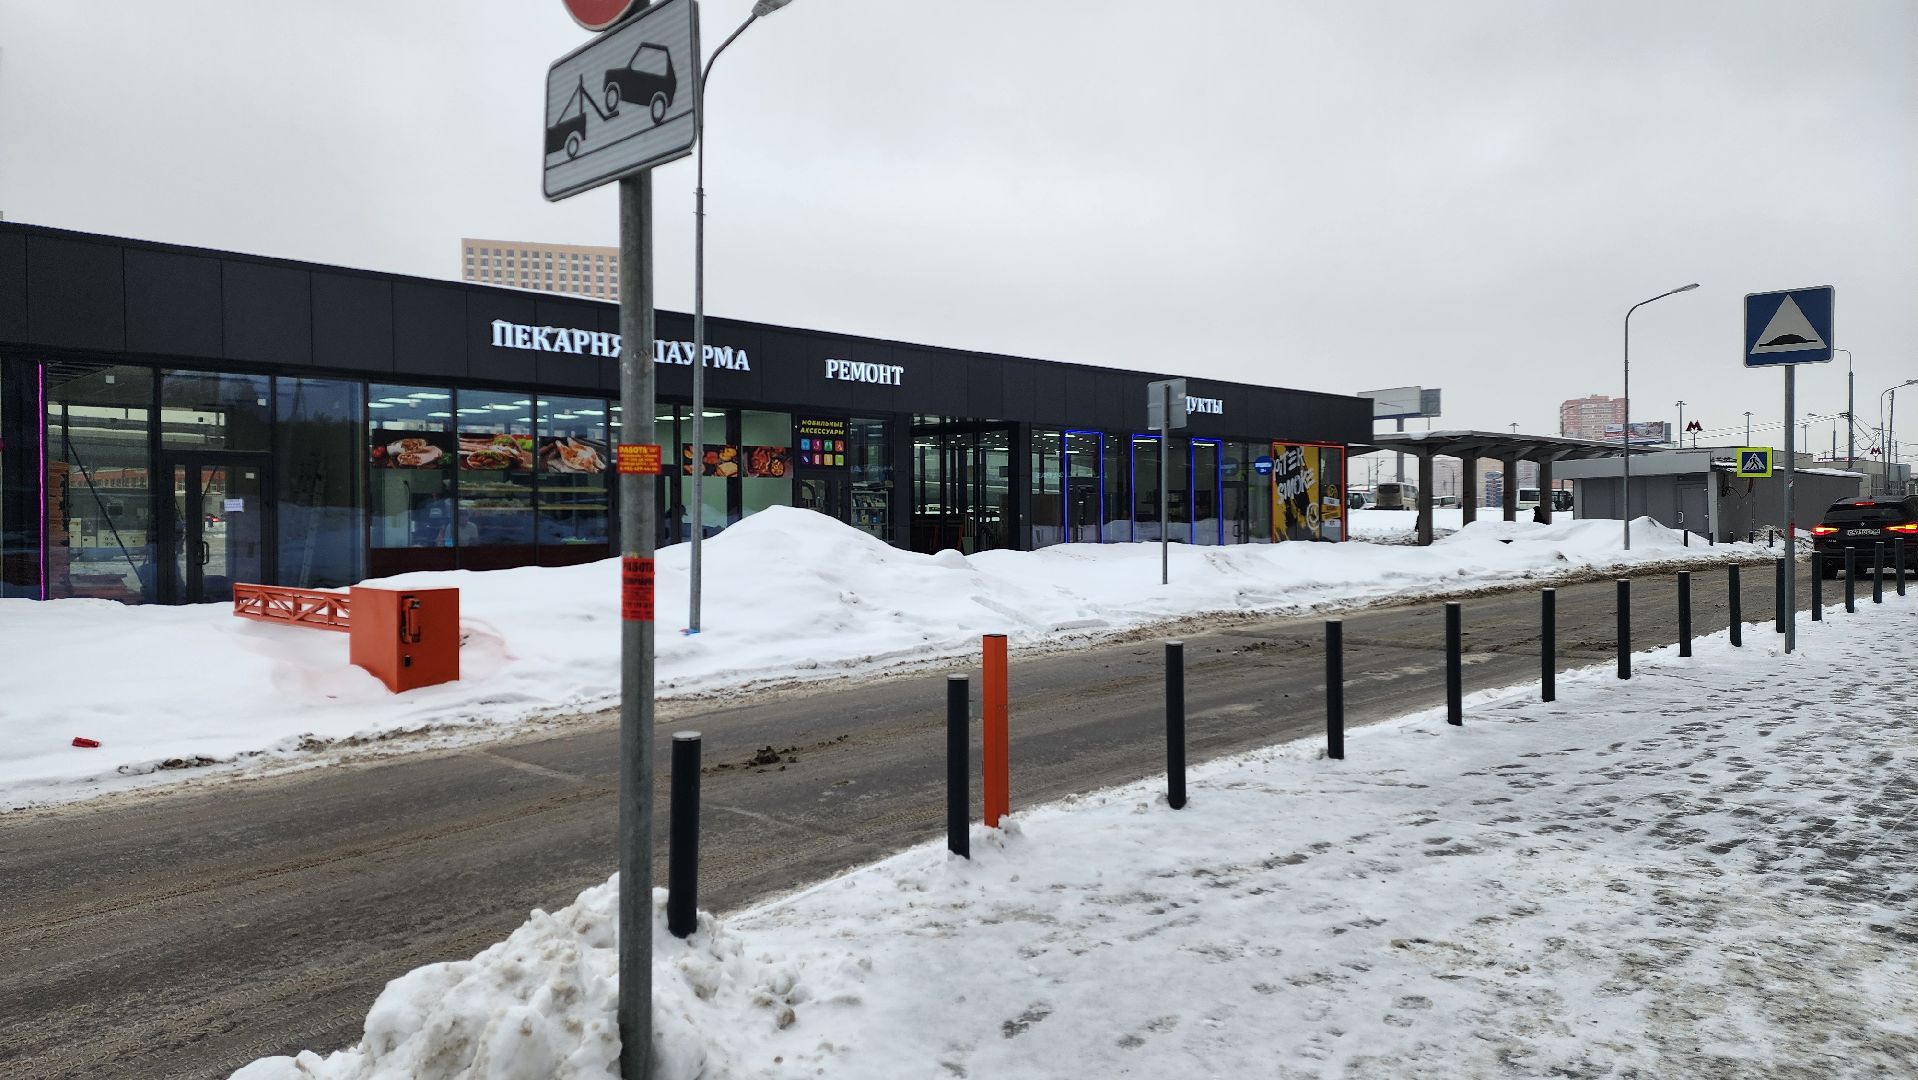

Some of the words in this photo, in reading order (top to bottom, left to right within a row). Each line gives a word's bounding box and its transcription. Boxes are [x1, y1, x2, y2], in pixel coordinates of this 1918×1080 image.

[491, 319, 622, 358] ПЕКАРНЯ
[825, 359, 904, 386] РЕМОНТ
[1185, 395, 1224, 415] ДУКТЫ
[800, 427, 845, 435] АКСЕССУАРЫ
[801, 419, 844, 428] МОБИЛЬНЫЕ
[619, 446, 648, 455] РАБОТА
[1278, 469, 1315, 505] SMOKE
